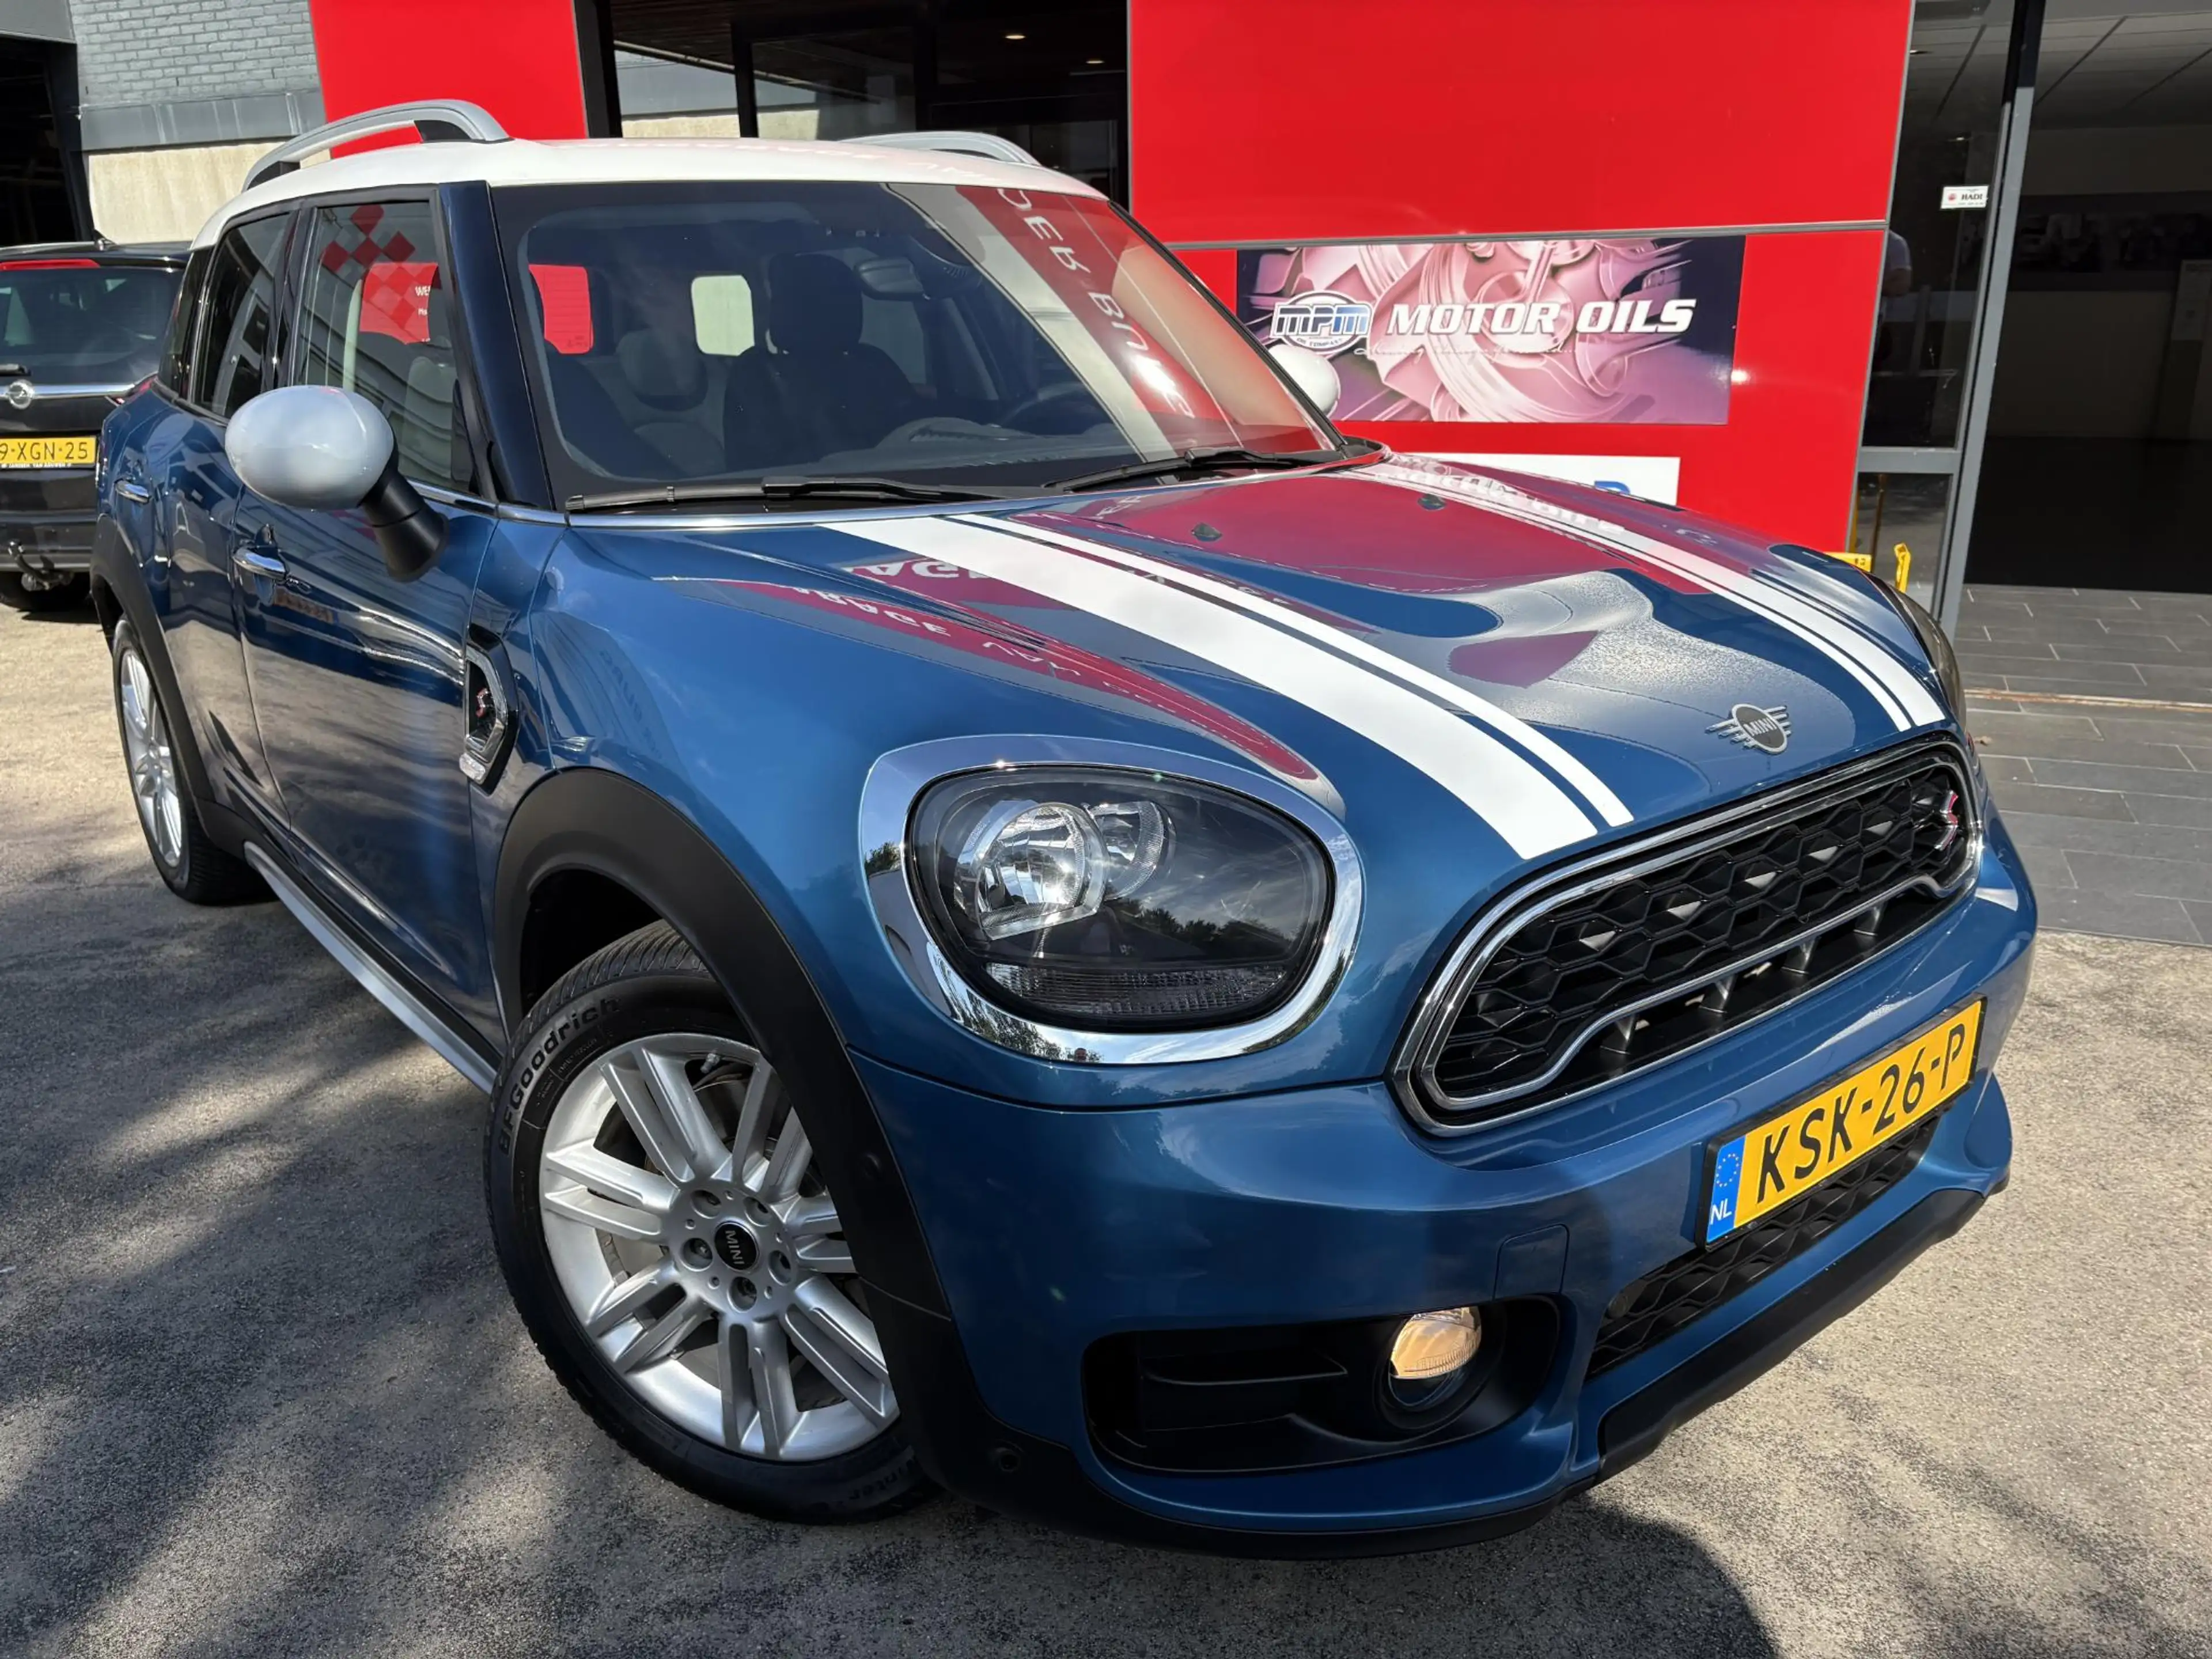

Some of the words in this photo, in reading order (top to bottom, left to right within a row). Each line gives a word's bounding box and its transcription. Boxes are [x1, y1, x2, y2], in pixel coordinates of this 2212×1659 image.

[1385, 302, 1560, 335] MOTOR
[1575, 298, 1697, 334] OILS
[1743, 717, 1777, 737] MINI
[498, 997, 620, 1155] BFGoodrich
[1756, 1022, 1965, 1205] KSK-26-P
[1710, 1198, 1733, 1225] NL
[725, 1229, 745, 1265] MINI
